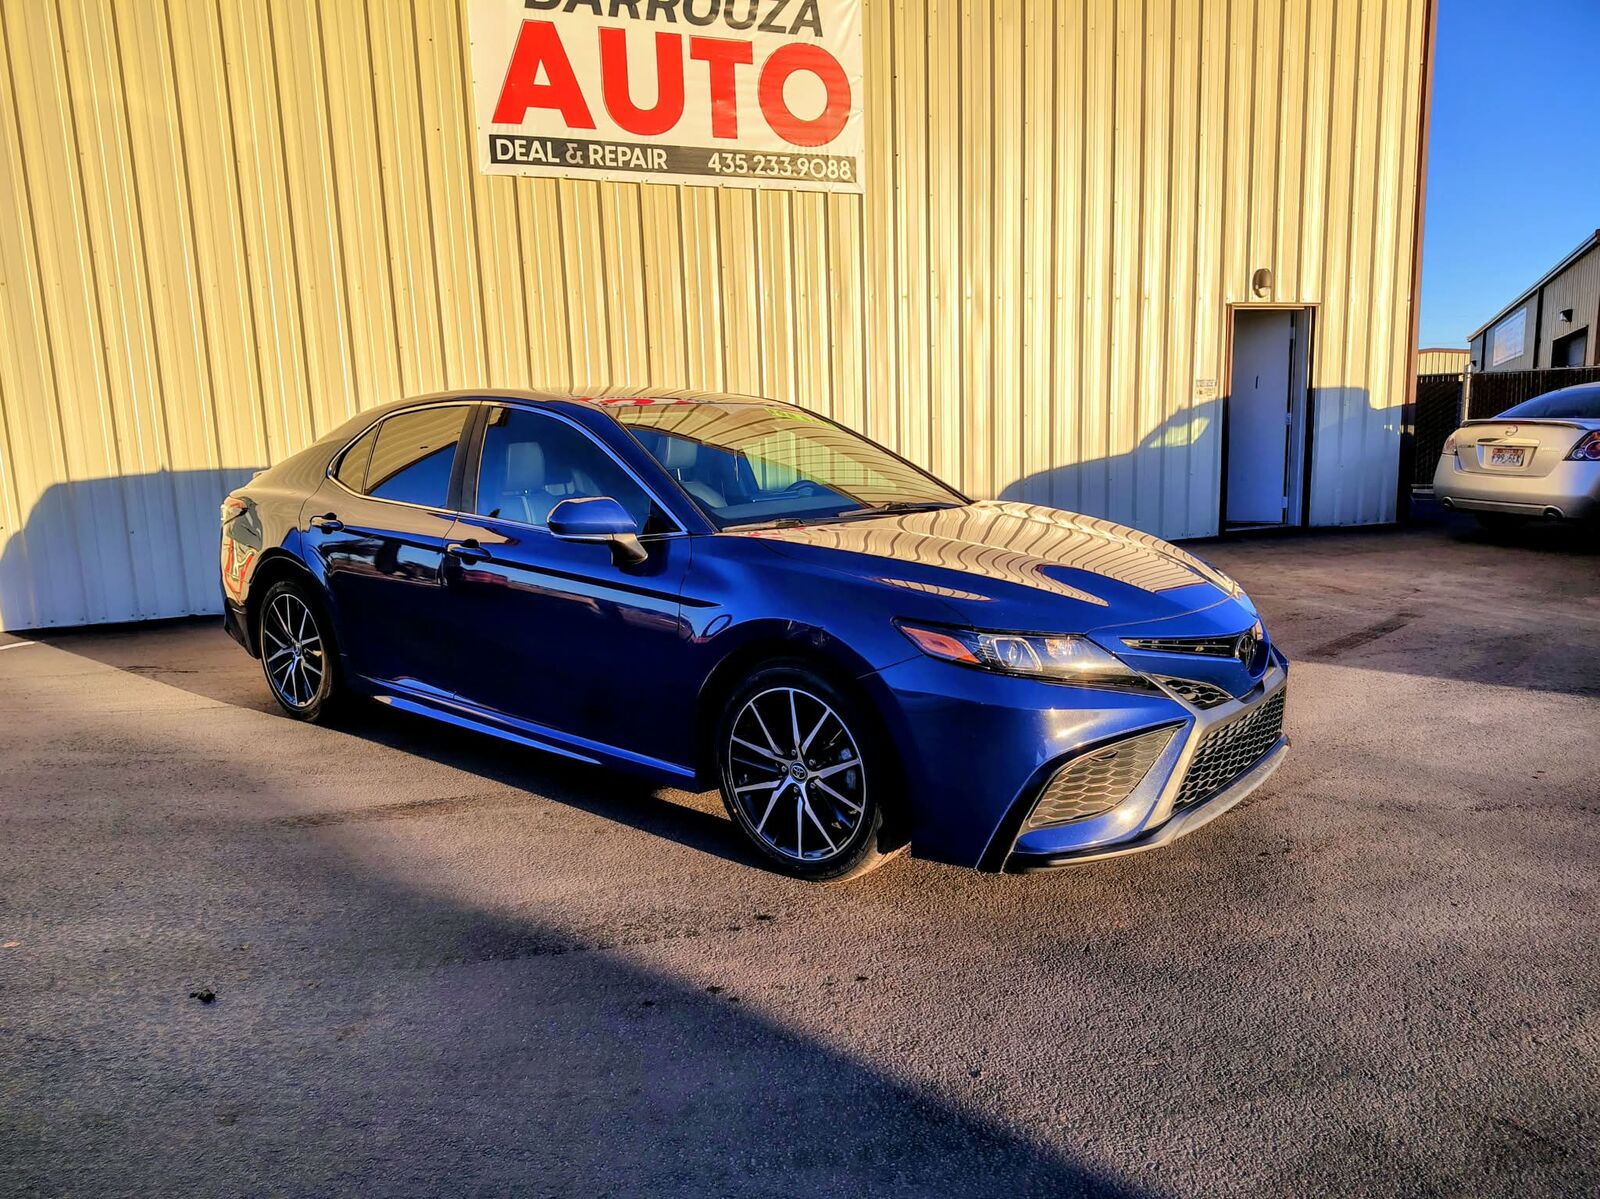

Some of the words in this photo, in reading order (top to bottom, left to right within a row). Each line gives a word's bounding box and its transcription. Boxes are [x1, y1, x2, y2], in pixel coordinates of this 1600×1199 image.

[525, 0, 823, 37] ROUZA
[491, 18, 852, 147] AUTO
[495, 138, 560, 163] DEAL
[564, 142, 584, 165] &
[588, 144, 668, 170] REPAIR
[707, 152, 851, 180] 435.233.9088
